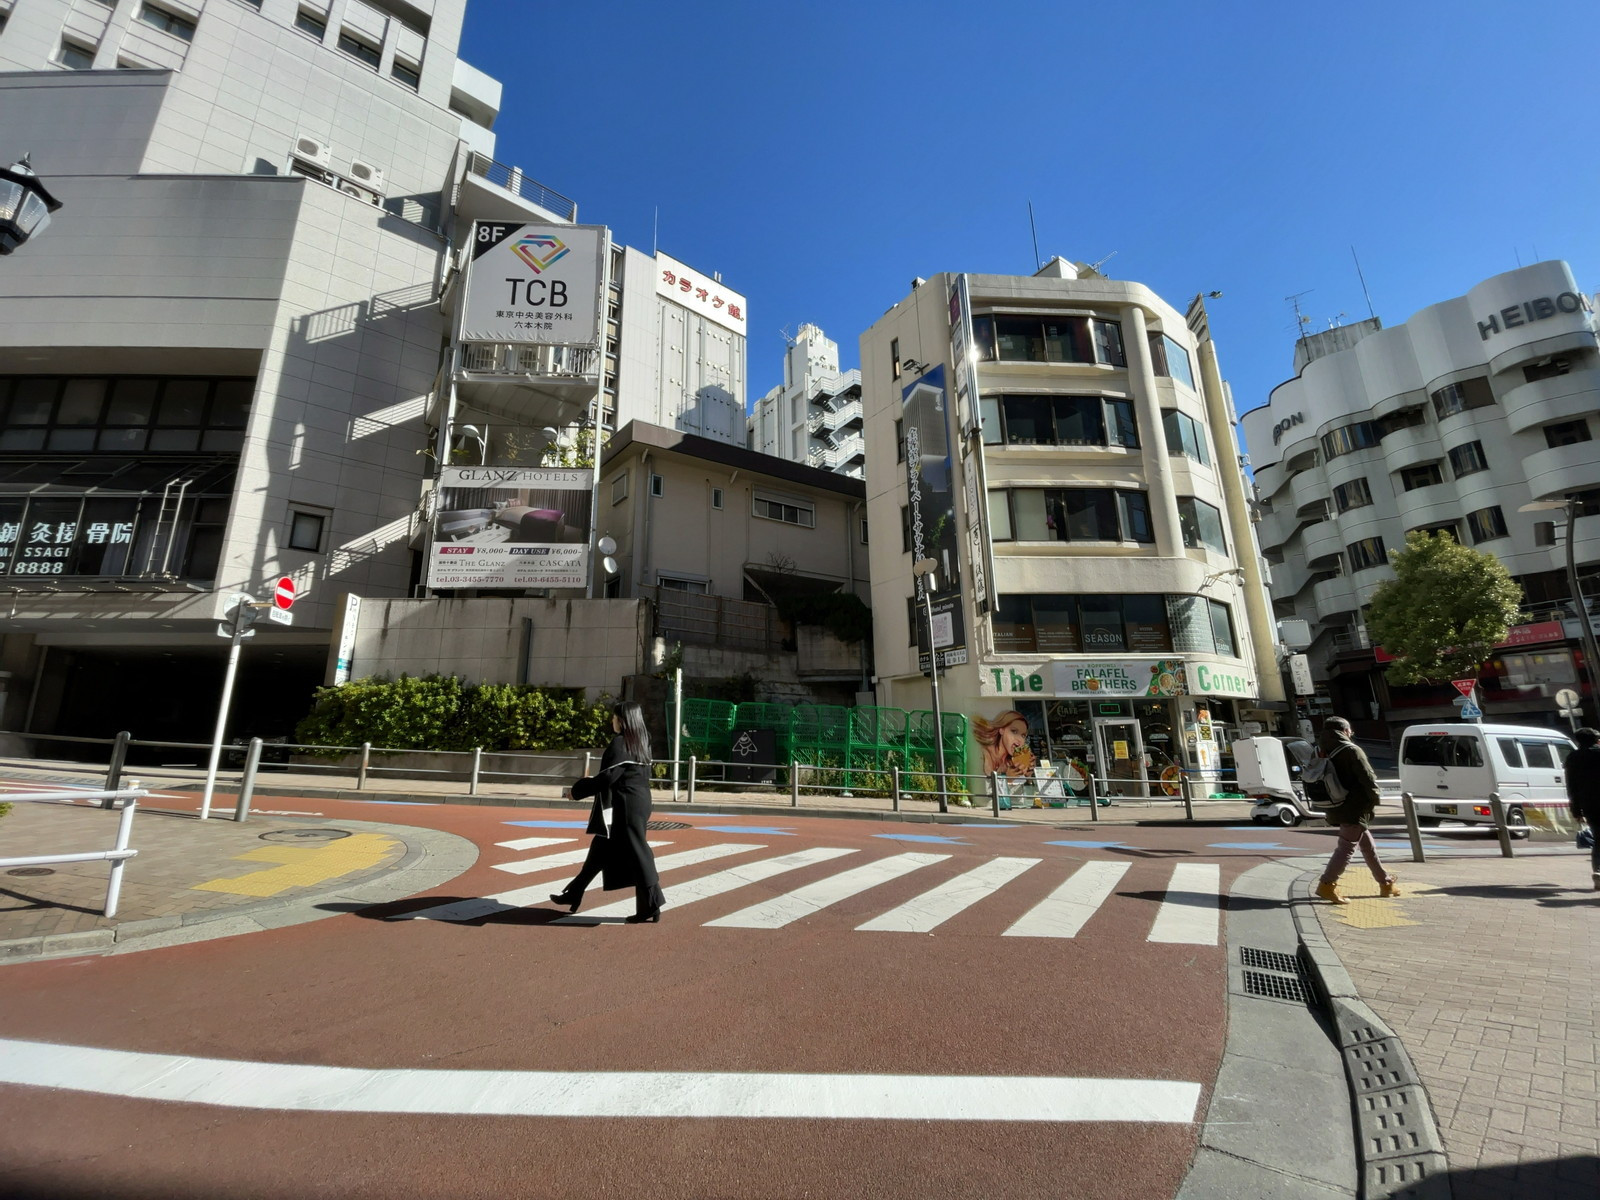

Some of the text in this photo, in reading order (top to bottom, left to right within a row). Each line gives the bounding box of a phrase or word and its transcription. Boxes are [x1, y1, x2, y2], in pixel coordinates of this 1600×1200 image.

[478, 226, 506, 243] 8F
[505, 277, 568, 307] TCB
[495, 310, 573, 321] 東京中央美容外科
[513, 321, 553, 331] 六本木院
[458, 469, 578, 482] GLANZ HOTELS
[1085, 633, 1123, 643] SEASON
[1076, 668, 1129, 679] FALAFEL
[1199, 665, 1247, 694] Corner
[990, 668, 1043, 693] The
